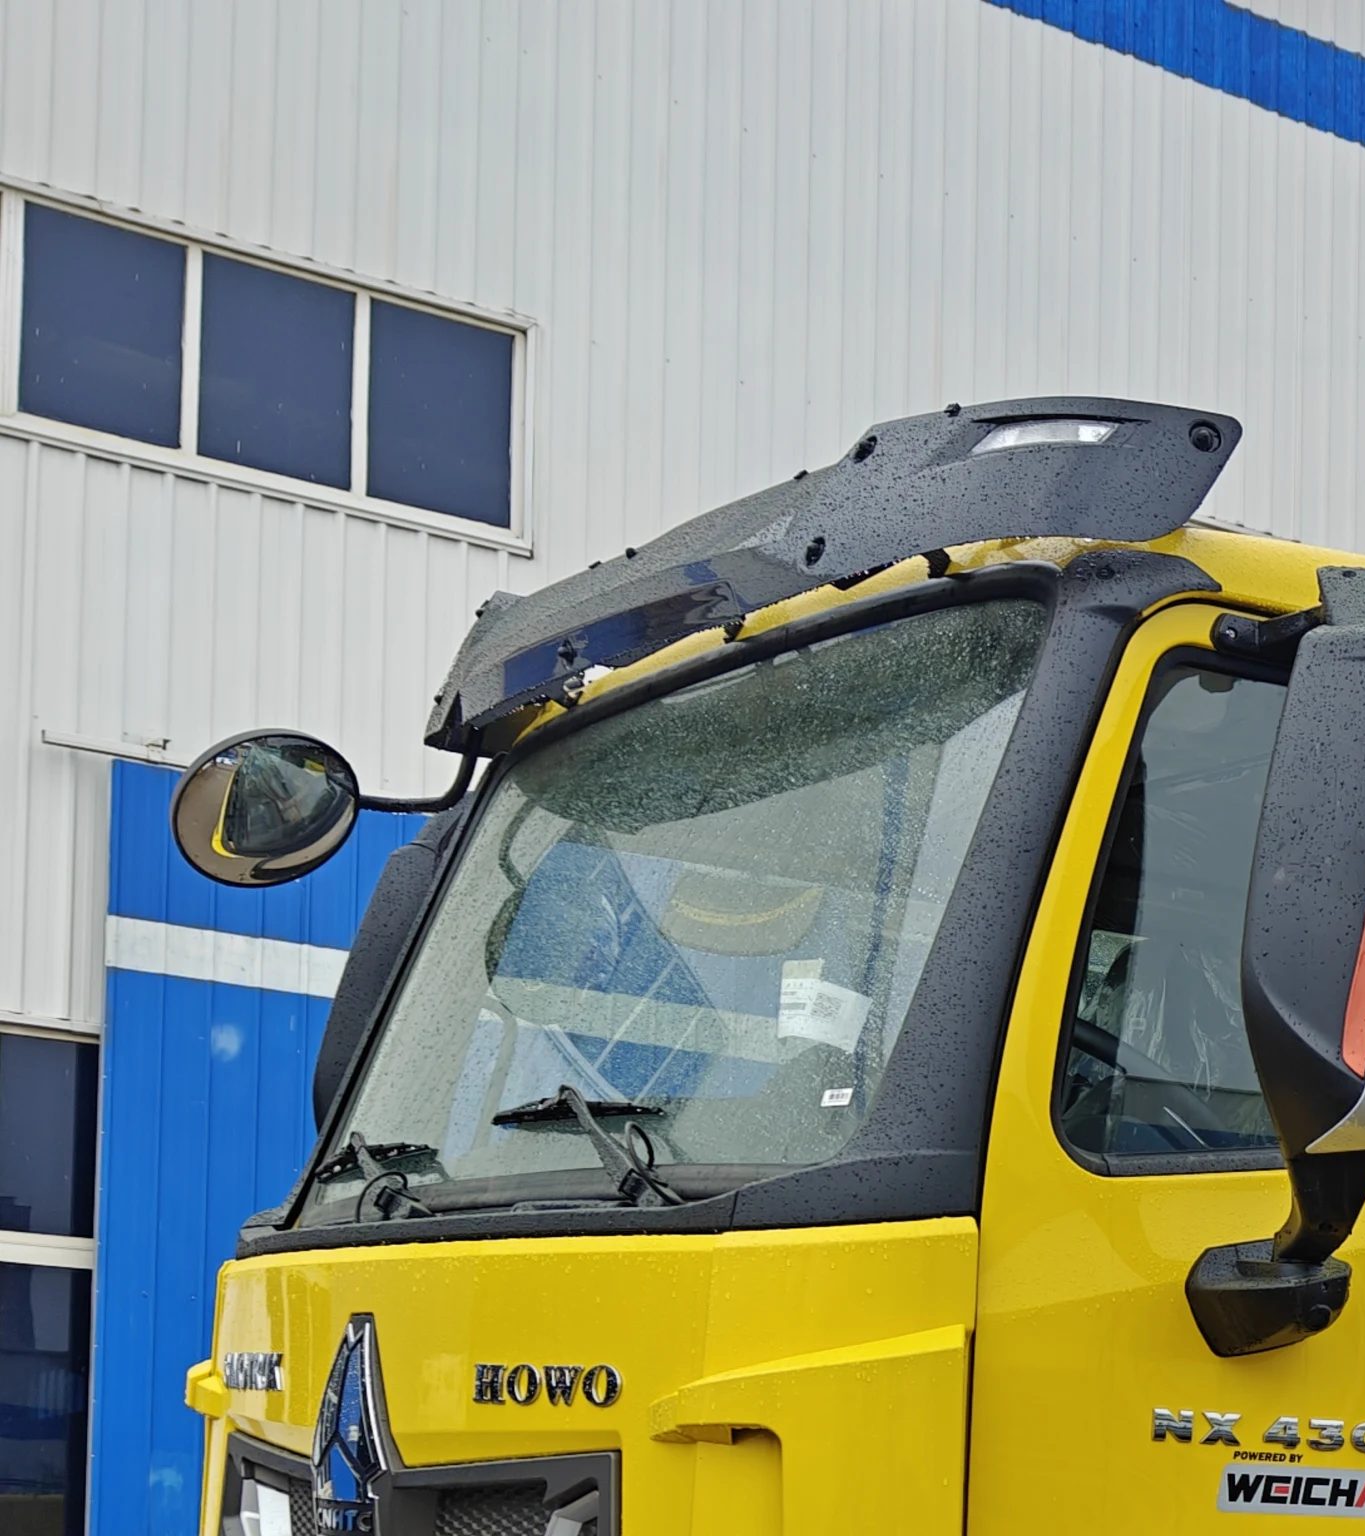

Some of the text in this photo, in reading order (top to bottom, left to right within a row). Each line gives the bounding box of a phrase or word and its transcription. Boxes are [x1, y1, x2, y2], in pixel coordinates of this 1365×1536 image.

[473, 1364, 623, 1408] HOWO
[1152, 1408, 1242, 1446] NX
[1233, 1451, 1304, 1463] POWERED BY
[317, 1507, 373, 1533] CNHTC
